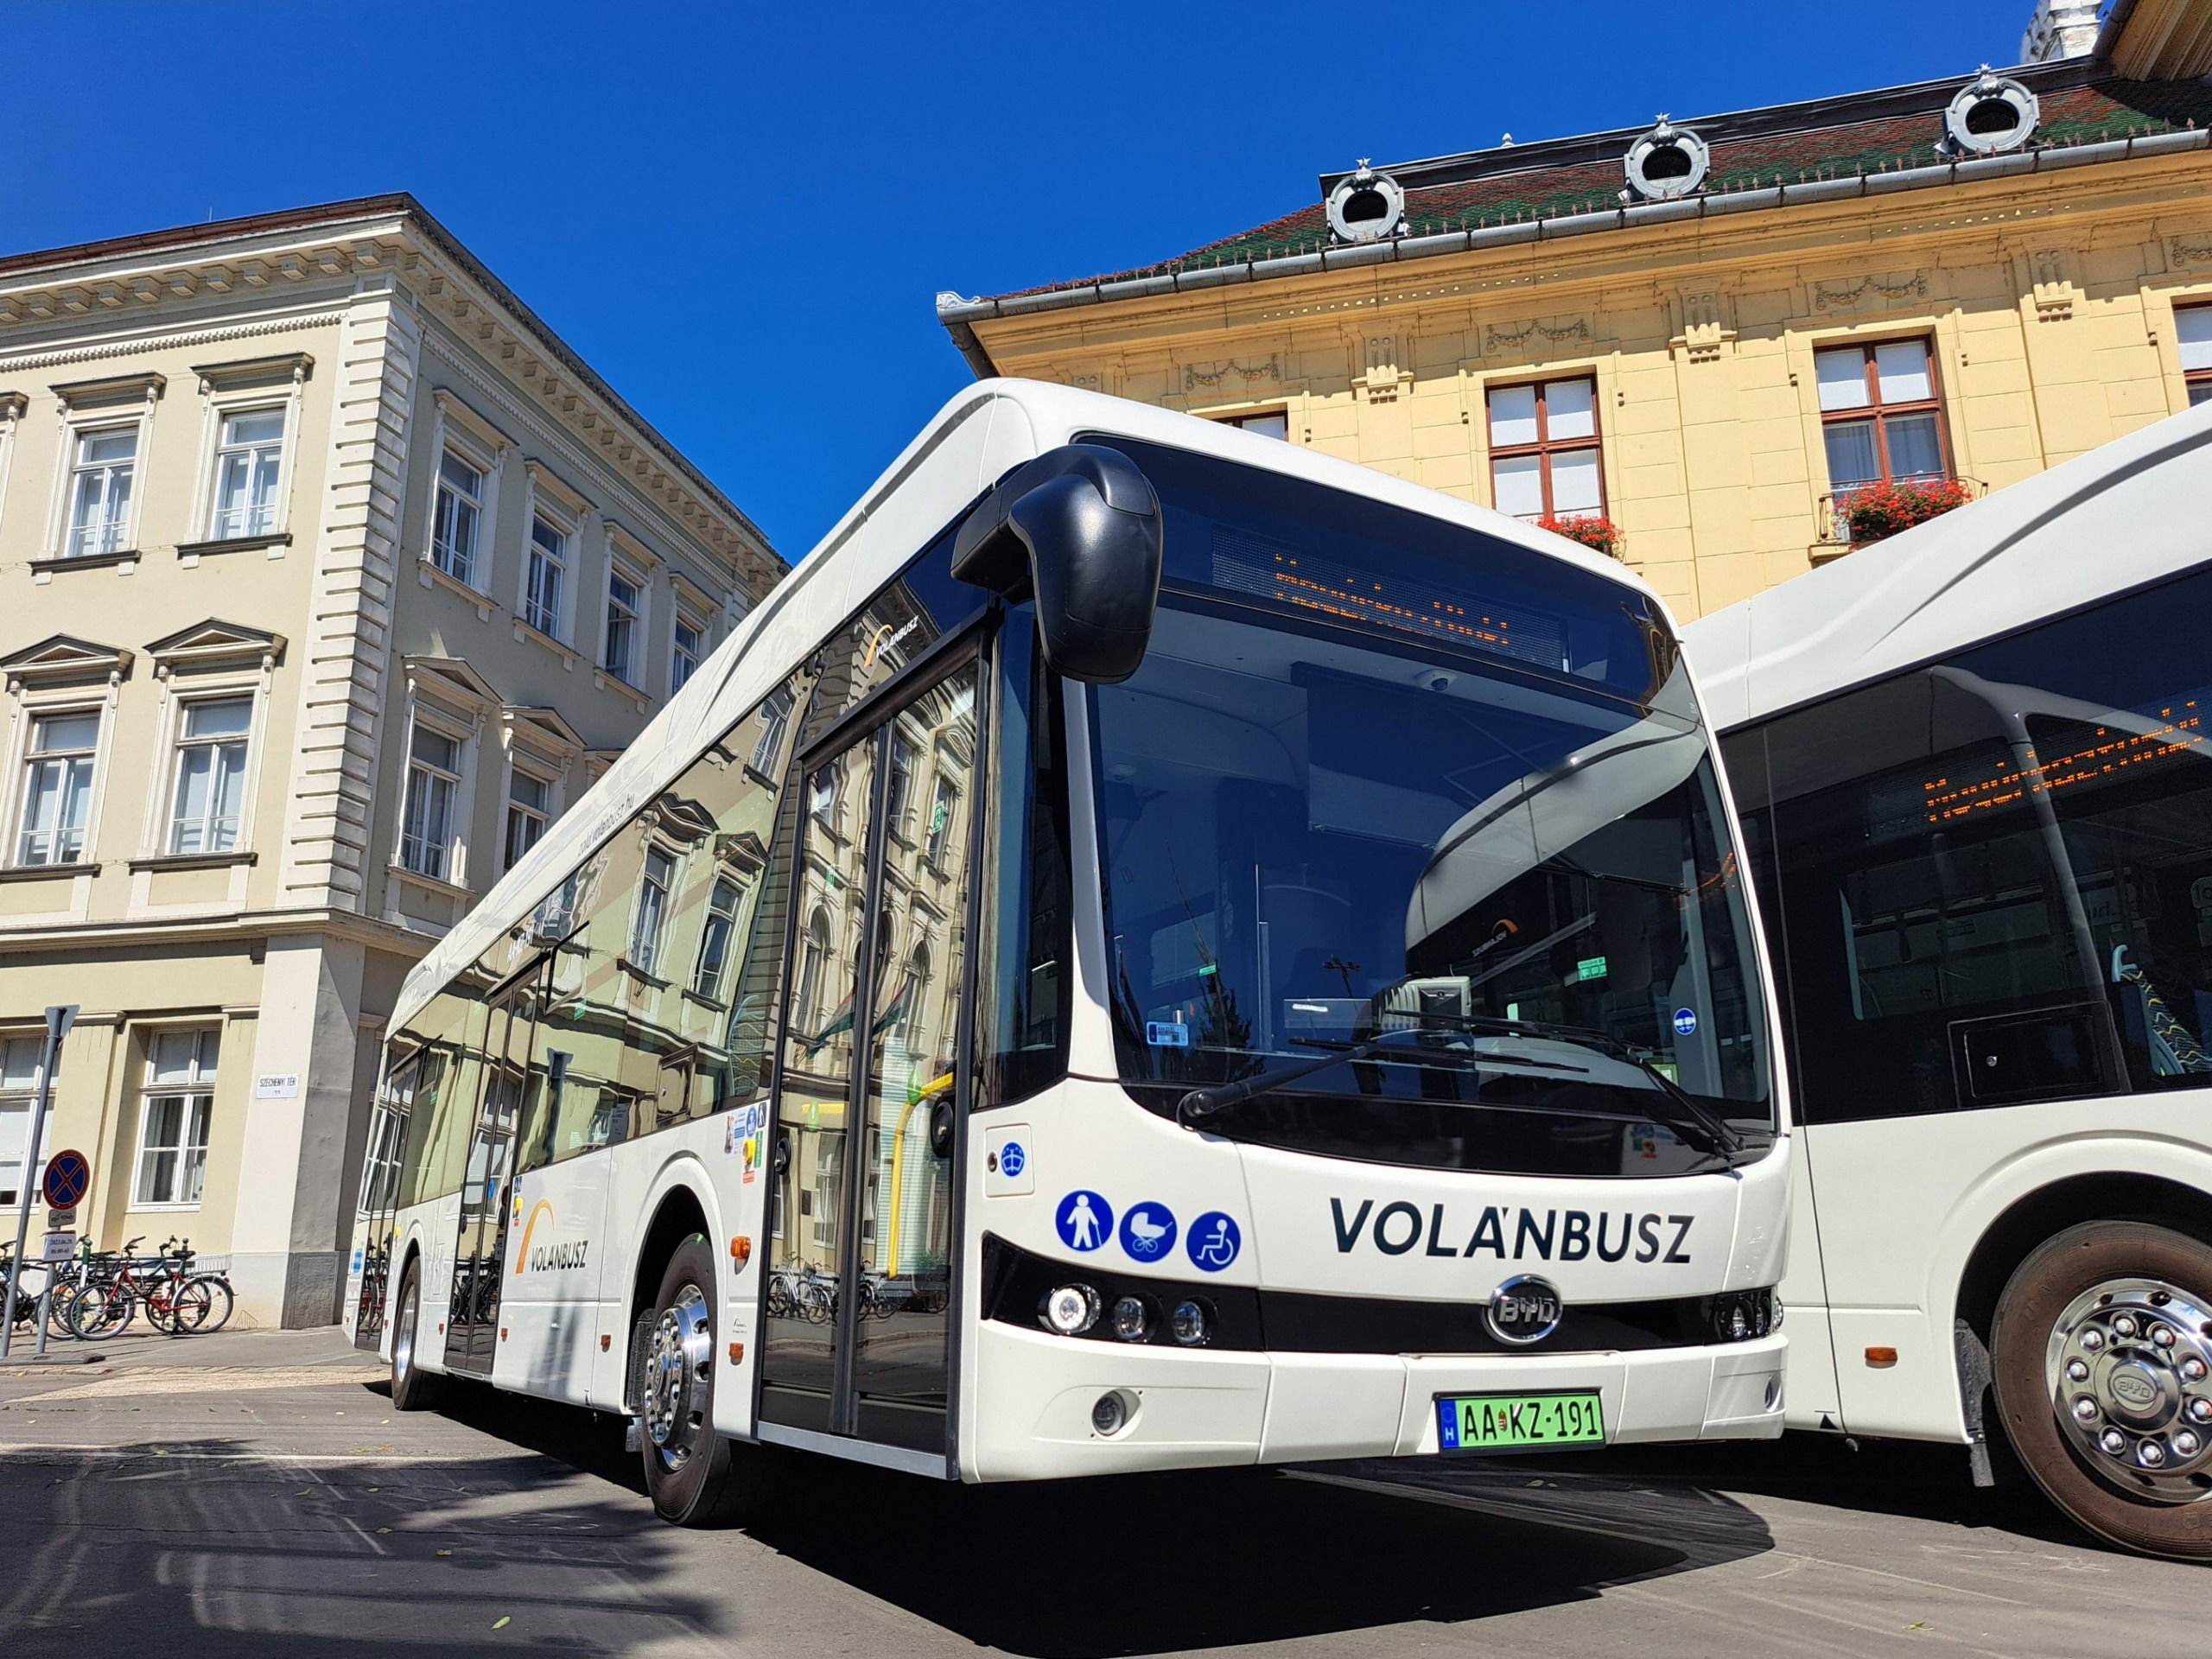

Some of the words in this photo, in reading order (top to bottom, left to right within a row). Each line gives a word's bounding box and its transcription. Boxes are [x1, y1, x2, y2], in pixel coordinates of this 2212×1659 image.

[1497, 1296, 1556, 1324] BYD
[2119, 1381, 2151, 1399] BYD
[1445, 1427, 1455, 1441] H
